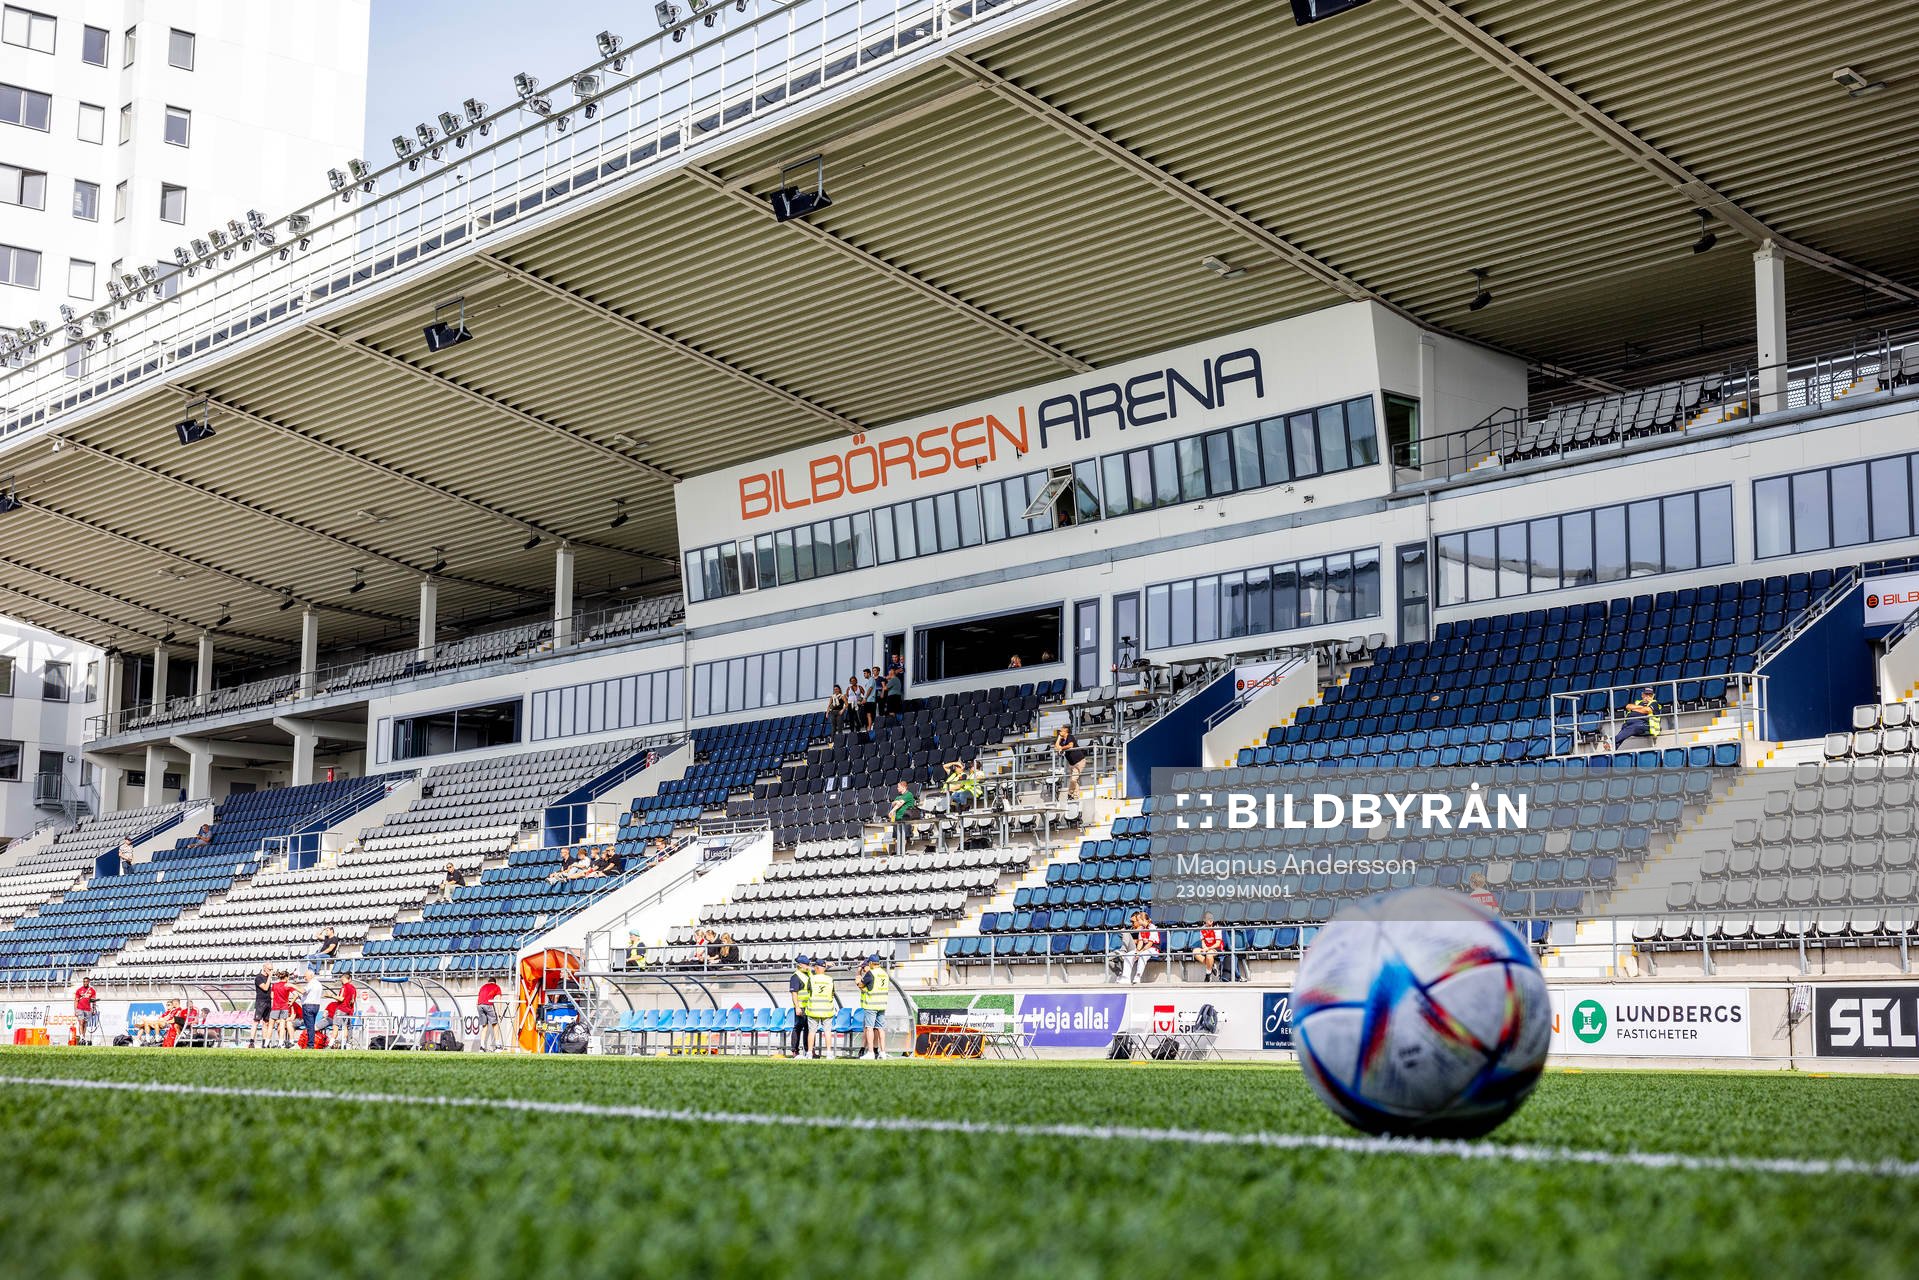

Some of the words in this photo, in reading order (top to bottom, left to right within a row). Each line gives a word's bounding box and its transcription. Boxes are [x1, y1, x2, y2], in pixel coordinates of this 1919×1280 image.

[739, 405, 1029, 520] BILBÖRSEN
[1037, 347, 1264, 449] ARENA
[1883, 591, 1919, 605] BILB
[1032, 1006, 1071, 1034] Heja
[1073, 1006, 1109, 1030] alla!
[1265, 997, 1294, 1033] Je
[1616, 1005, 1742, 1023] LUNDBERGS
[1829, 998, 1919, 1047] SEL
[1280, 1027, 1293, 1035] REK
[1616, 1028, 1698, 1040] FASTIGHETER
